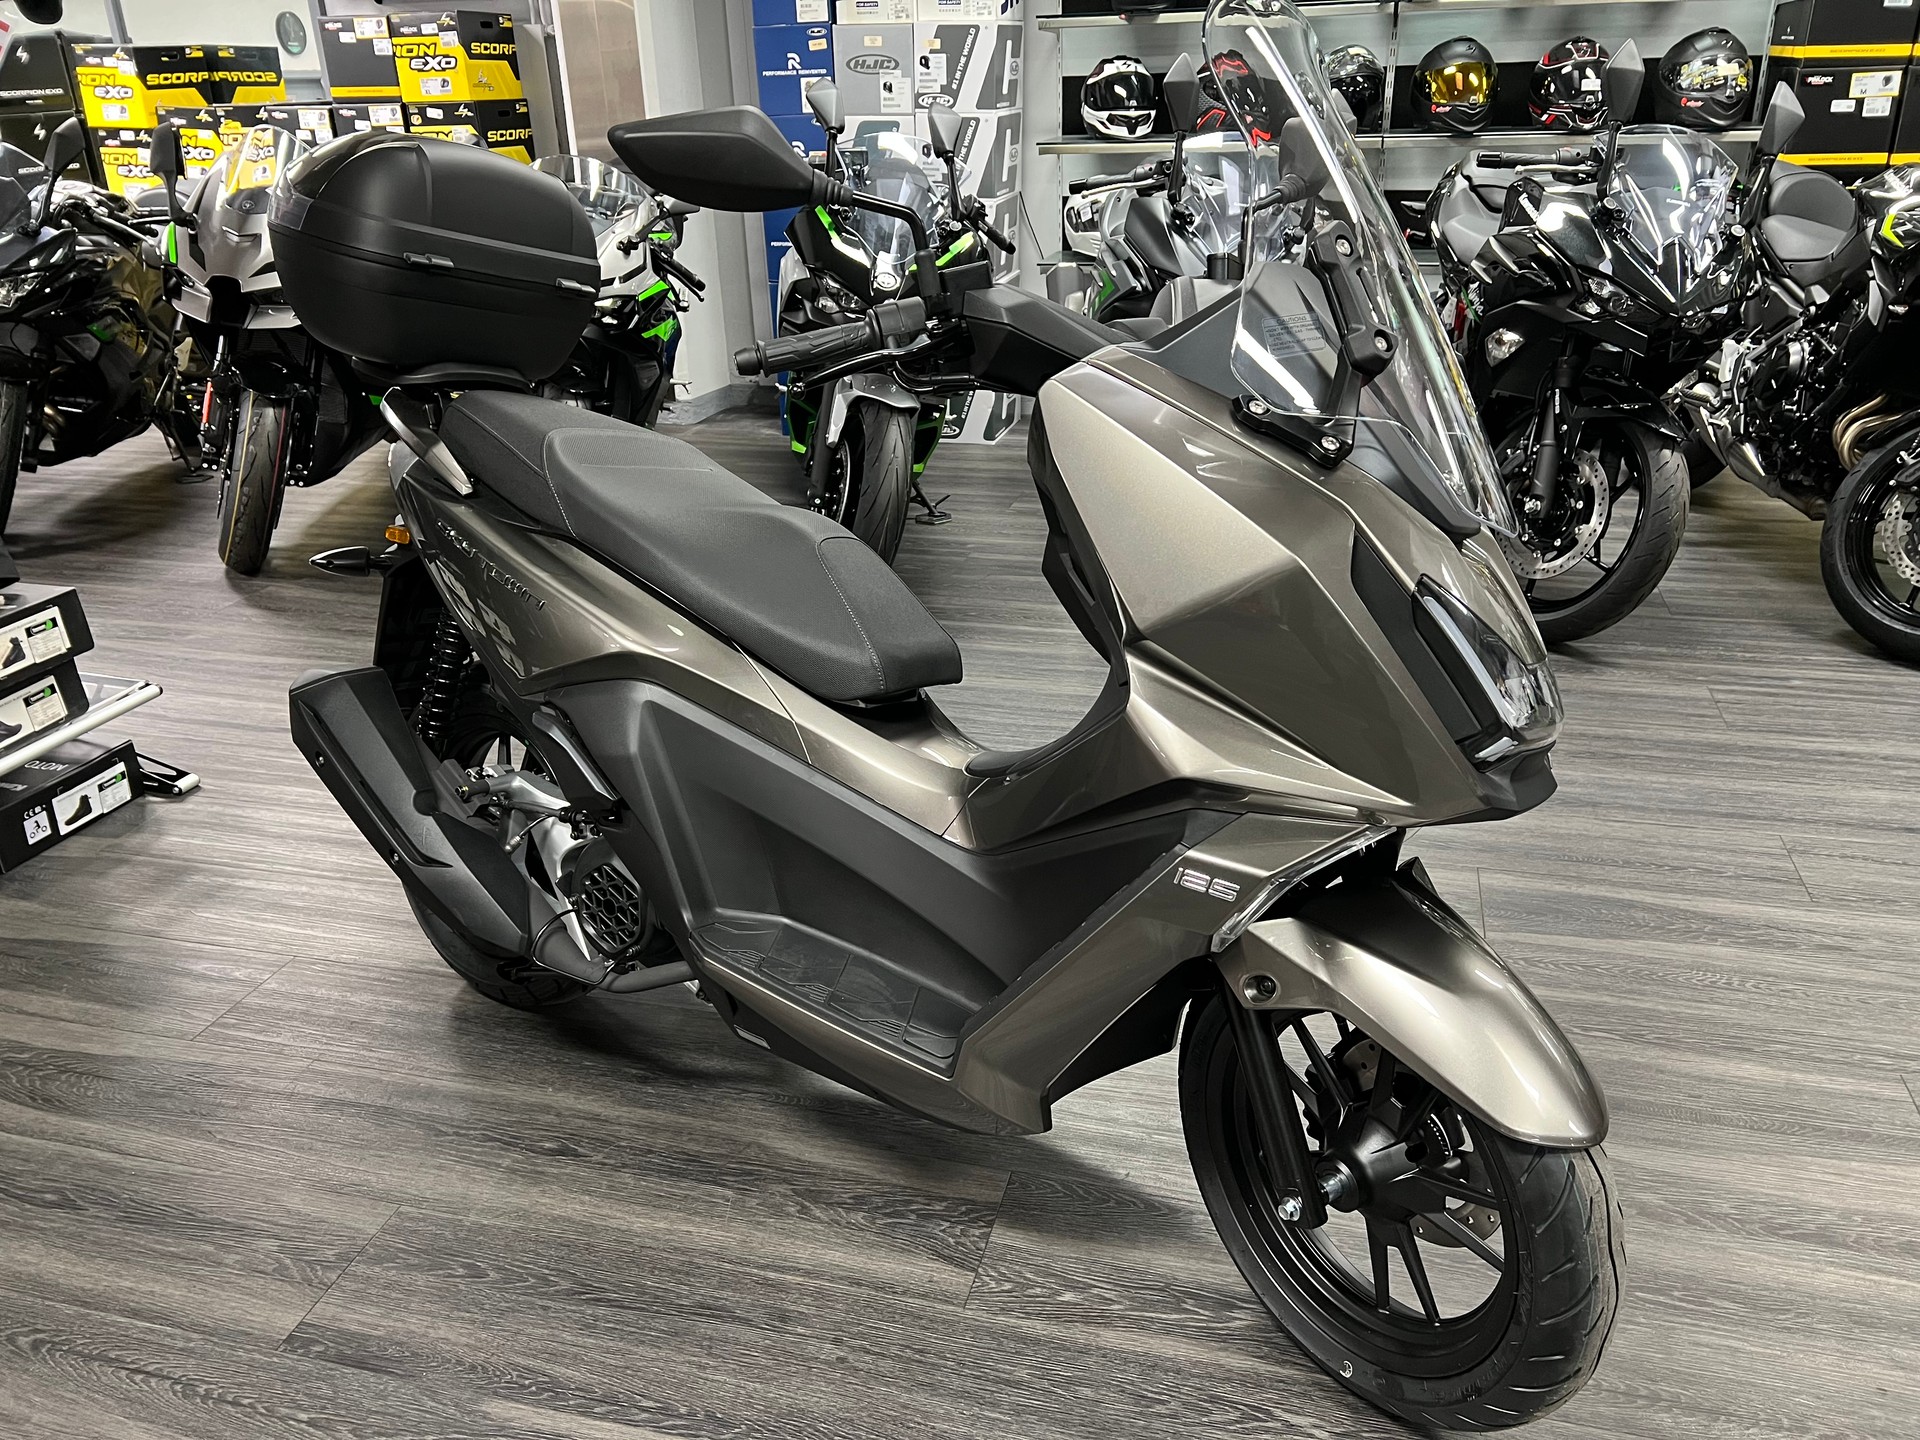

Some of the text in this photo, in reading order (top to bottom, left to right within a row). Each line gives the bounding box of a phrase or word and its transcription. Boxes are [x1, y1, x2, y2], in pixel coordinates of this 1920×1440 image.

[392, 43, 437, 57] ION
[957, 55, 967, 71] THE
[962, 27, 976, 56] WORLD
[853, 59, 892, 70] HJC
[78, 74, 115, 85] ION
[0, 89, 45, 97] SCORPION
[963, 119, 977, 145] WORLD
[1173, 867, 1241, 902] 125
